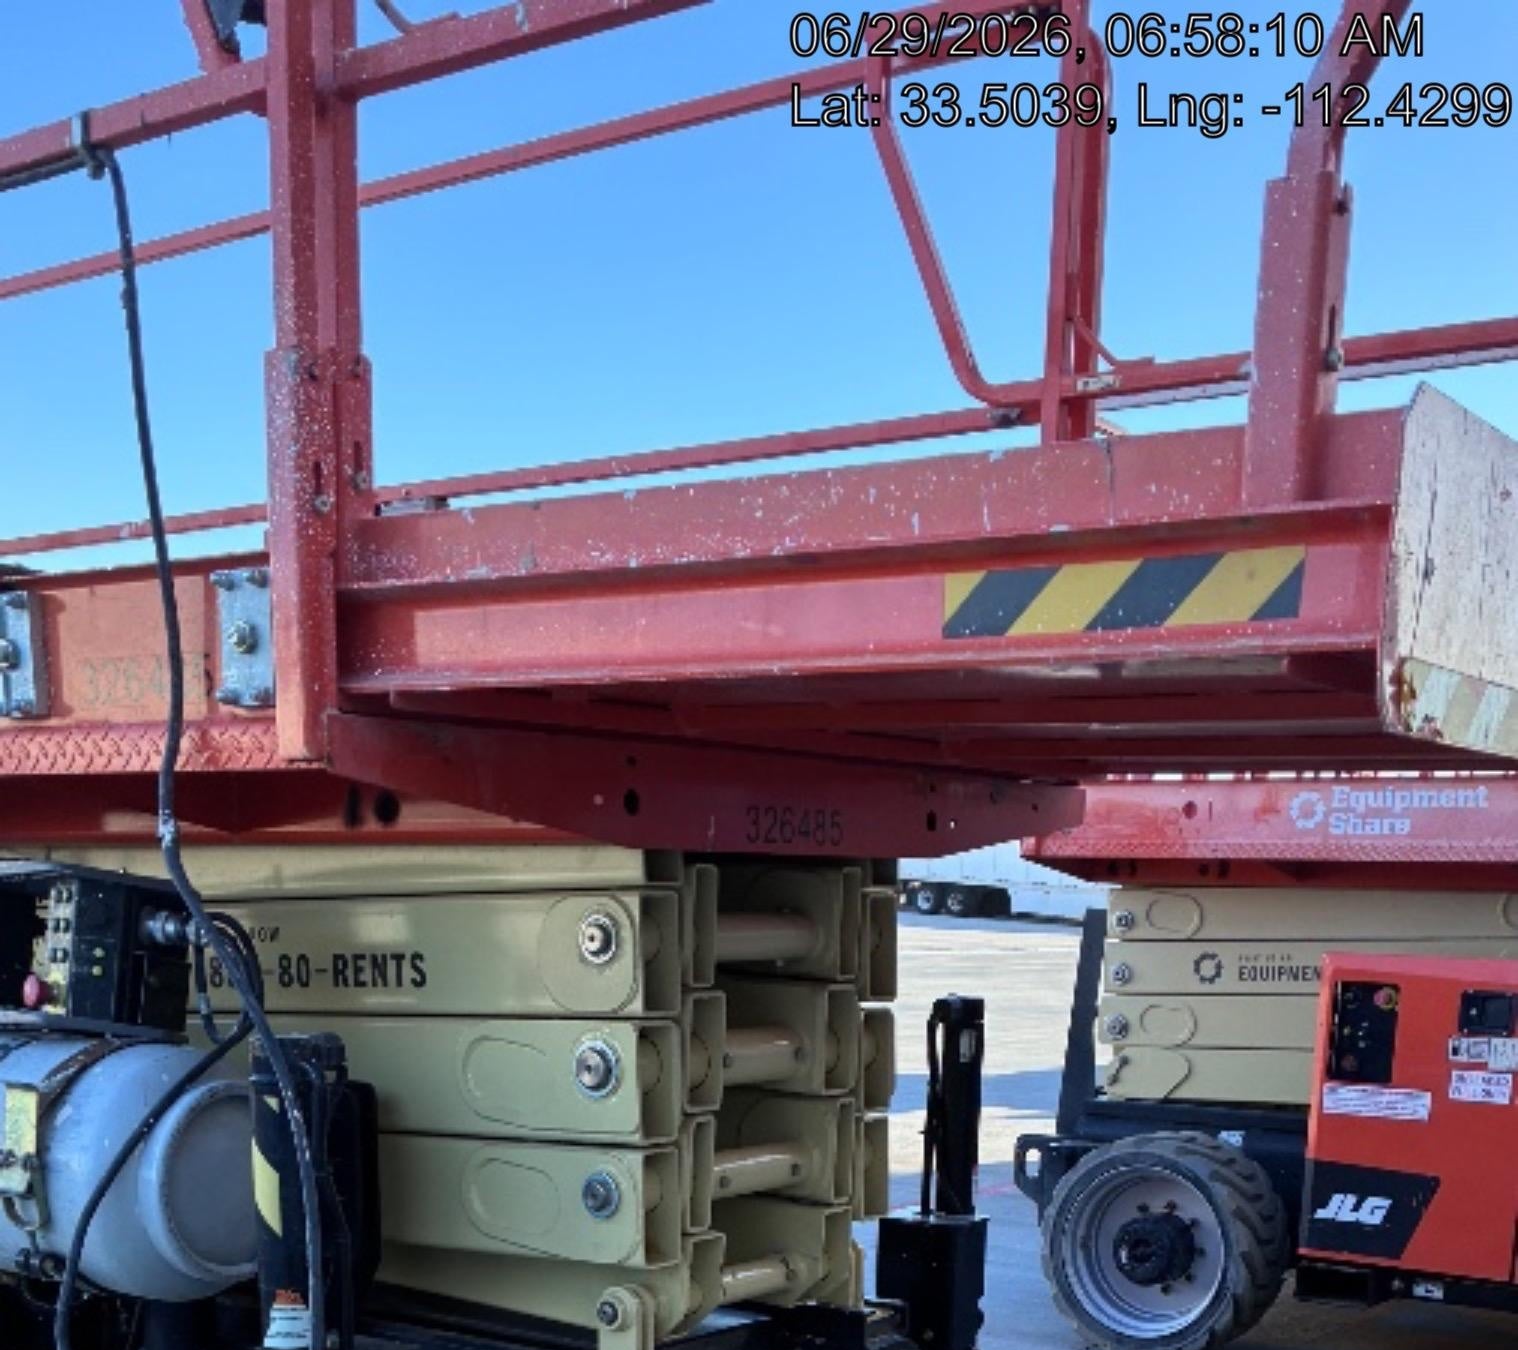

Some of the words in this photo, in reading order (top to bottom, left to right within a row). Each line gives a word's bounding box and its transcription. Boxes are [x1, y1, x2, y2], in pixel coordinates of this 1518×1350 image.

[1330, 784, 1489, 814] Equipment
[745, 805, 844, 847] 326485
[1328, 812, 1411, 835] Share
[209, 952, 427, 989] 8-80-RENTS
[1313, 1193, 1393, 1225] JLG
